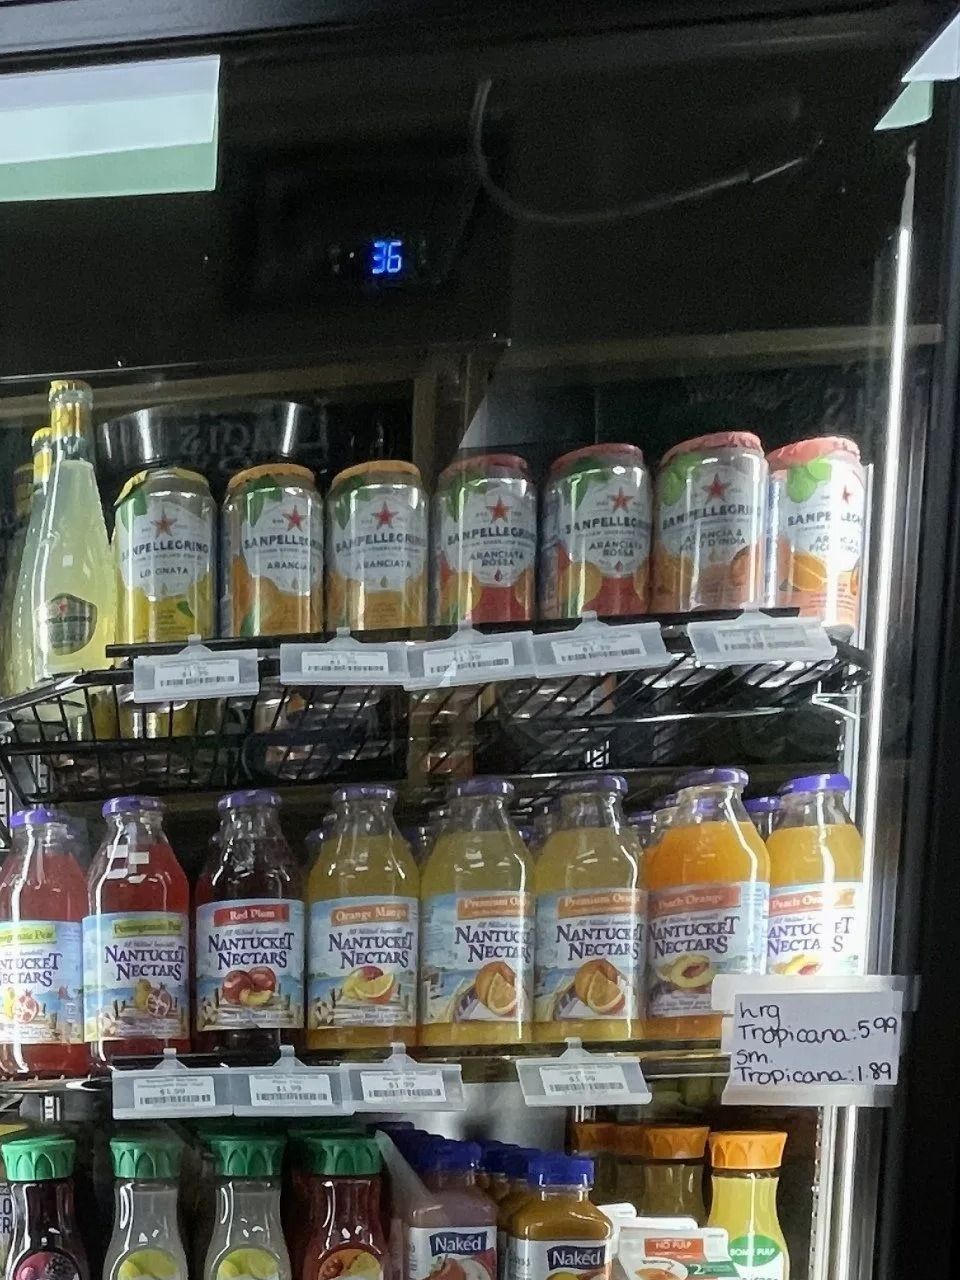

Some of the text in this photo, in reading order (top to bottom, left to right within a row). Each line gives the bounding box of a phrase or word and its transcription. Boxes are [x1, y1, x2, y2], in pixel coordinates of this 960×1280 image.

[373, 241, 402, 274] 36
[230, 910, 247, 921] Red
[336, 910, 372, 923] Orange
[208, 932, 294, 954] NANTUCKET
[328, 932, 414, 954] NANTUCKET
[655, 934, 728, 959] NECTARS
[105, 944, 185, 967] NANTUCKET
[218, 952, 287, 971] NECTARS
[340, 951, 409, 970] NECTARS
[116, 962, 181, 982] NECTARS
[434, 1234, 483, 1252] Naked
[655, 1242, 692, 1250] NO PULP
[756, 1247, 776, 1257] PULP
[552, 1250, 602, 1267] Naked
